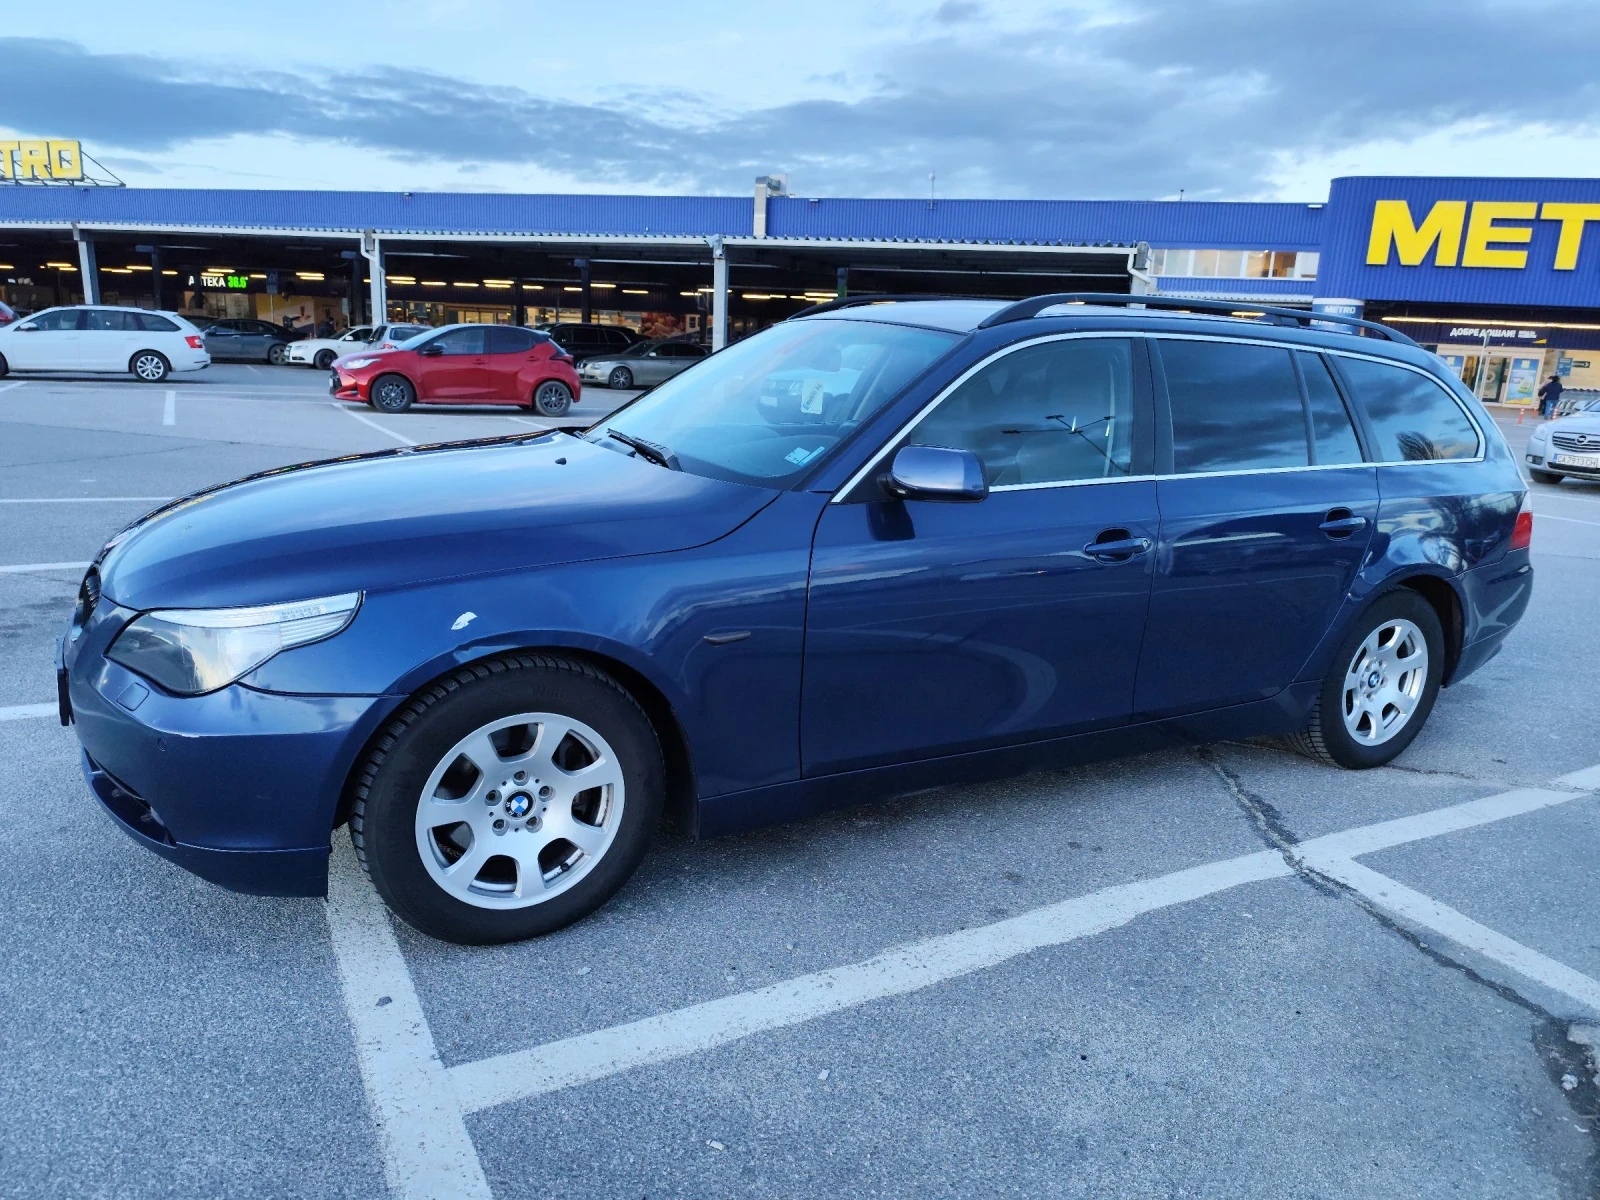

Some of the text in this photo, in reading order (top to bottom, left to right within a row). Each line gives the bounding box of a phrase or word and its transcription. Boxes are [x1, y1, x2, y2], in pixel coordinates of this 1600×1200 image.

[1366, 200, 1600, 270] MET
[188, 275, 226, 287] АТЕКА
[1324, 305, 1356, 315] METRO
[1450, 328, 1479, 337] ДОБРЕ
